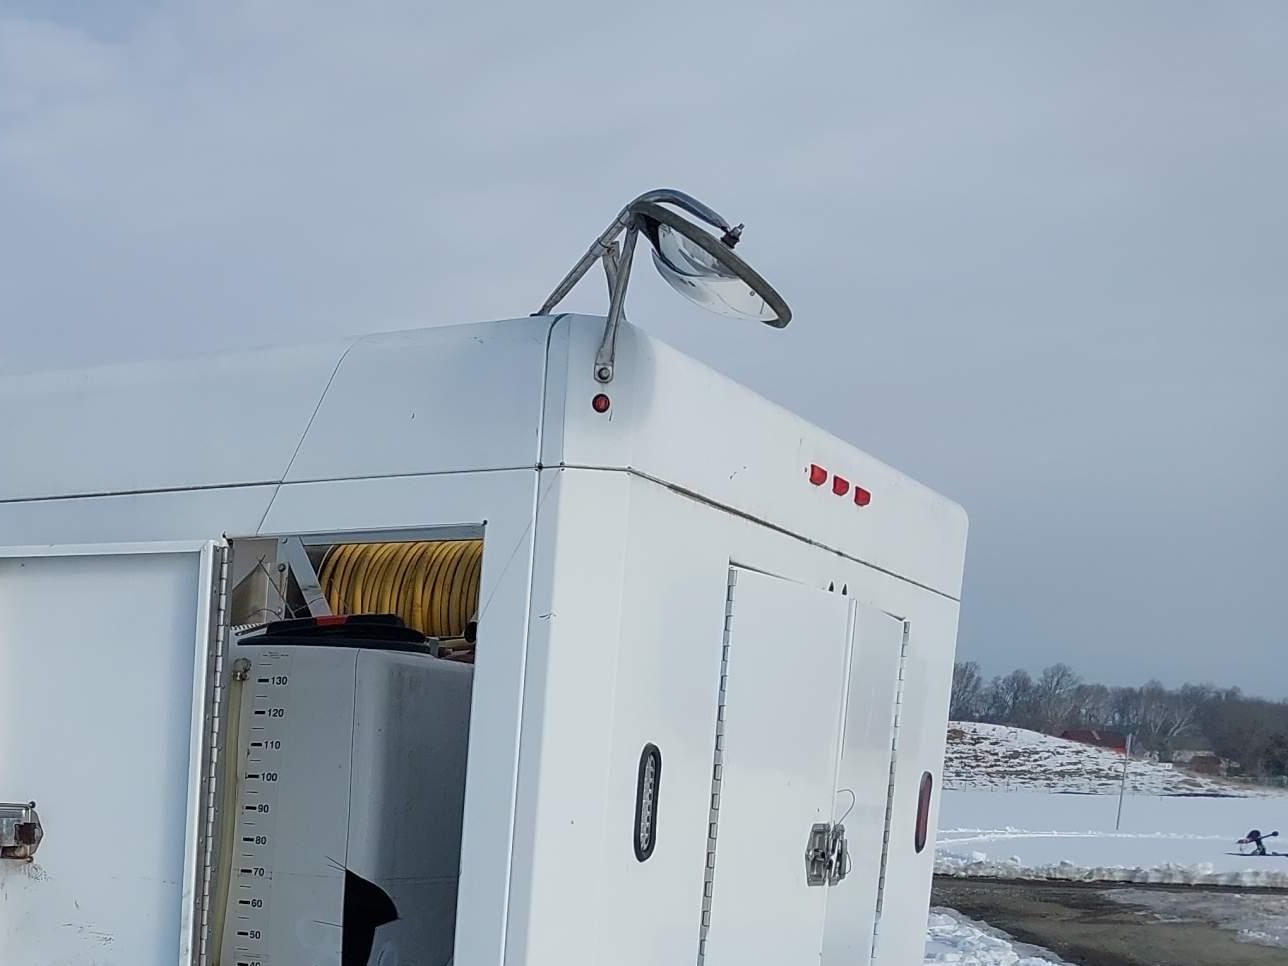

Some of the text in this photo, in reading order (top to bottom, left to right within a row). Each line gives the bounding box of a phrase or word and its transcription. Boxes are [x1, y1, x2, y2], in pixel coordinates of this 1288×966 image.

[272, 676, 288, 686] 130
[268, 708, 284, 718] 120
[264, 741, 281, 750] 110
[261, 772, 278, 782] 100
[257, 804, 269, 813] 90
[255, 836, 267, 845] 80
[253, 868, 265, 877] 70
[251, 899, 263, 908] 60
[249, 931, 261, 939] 50
